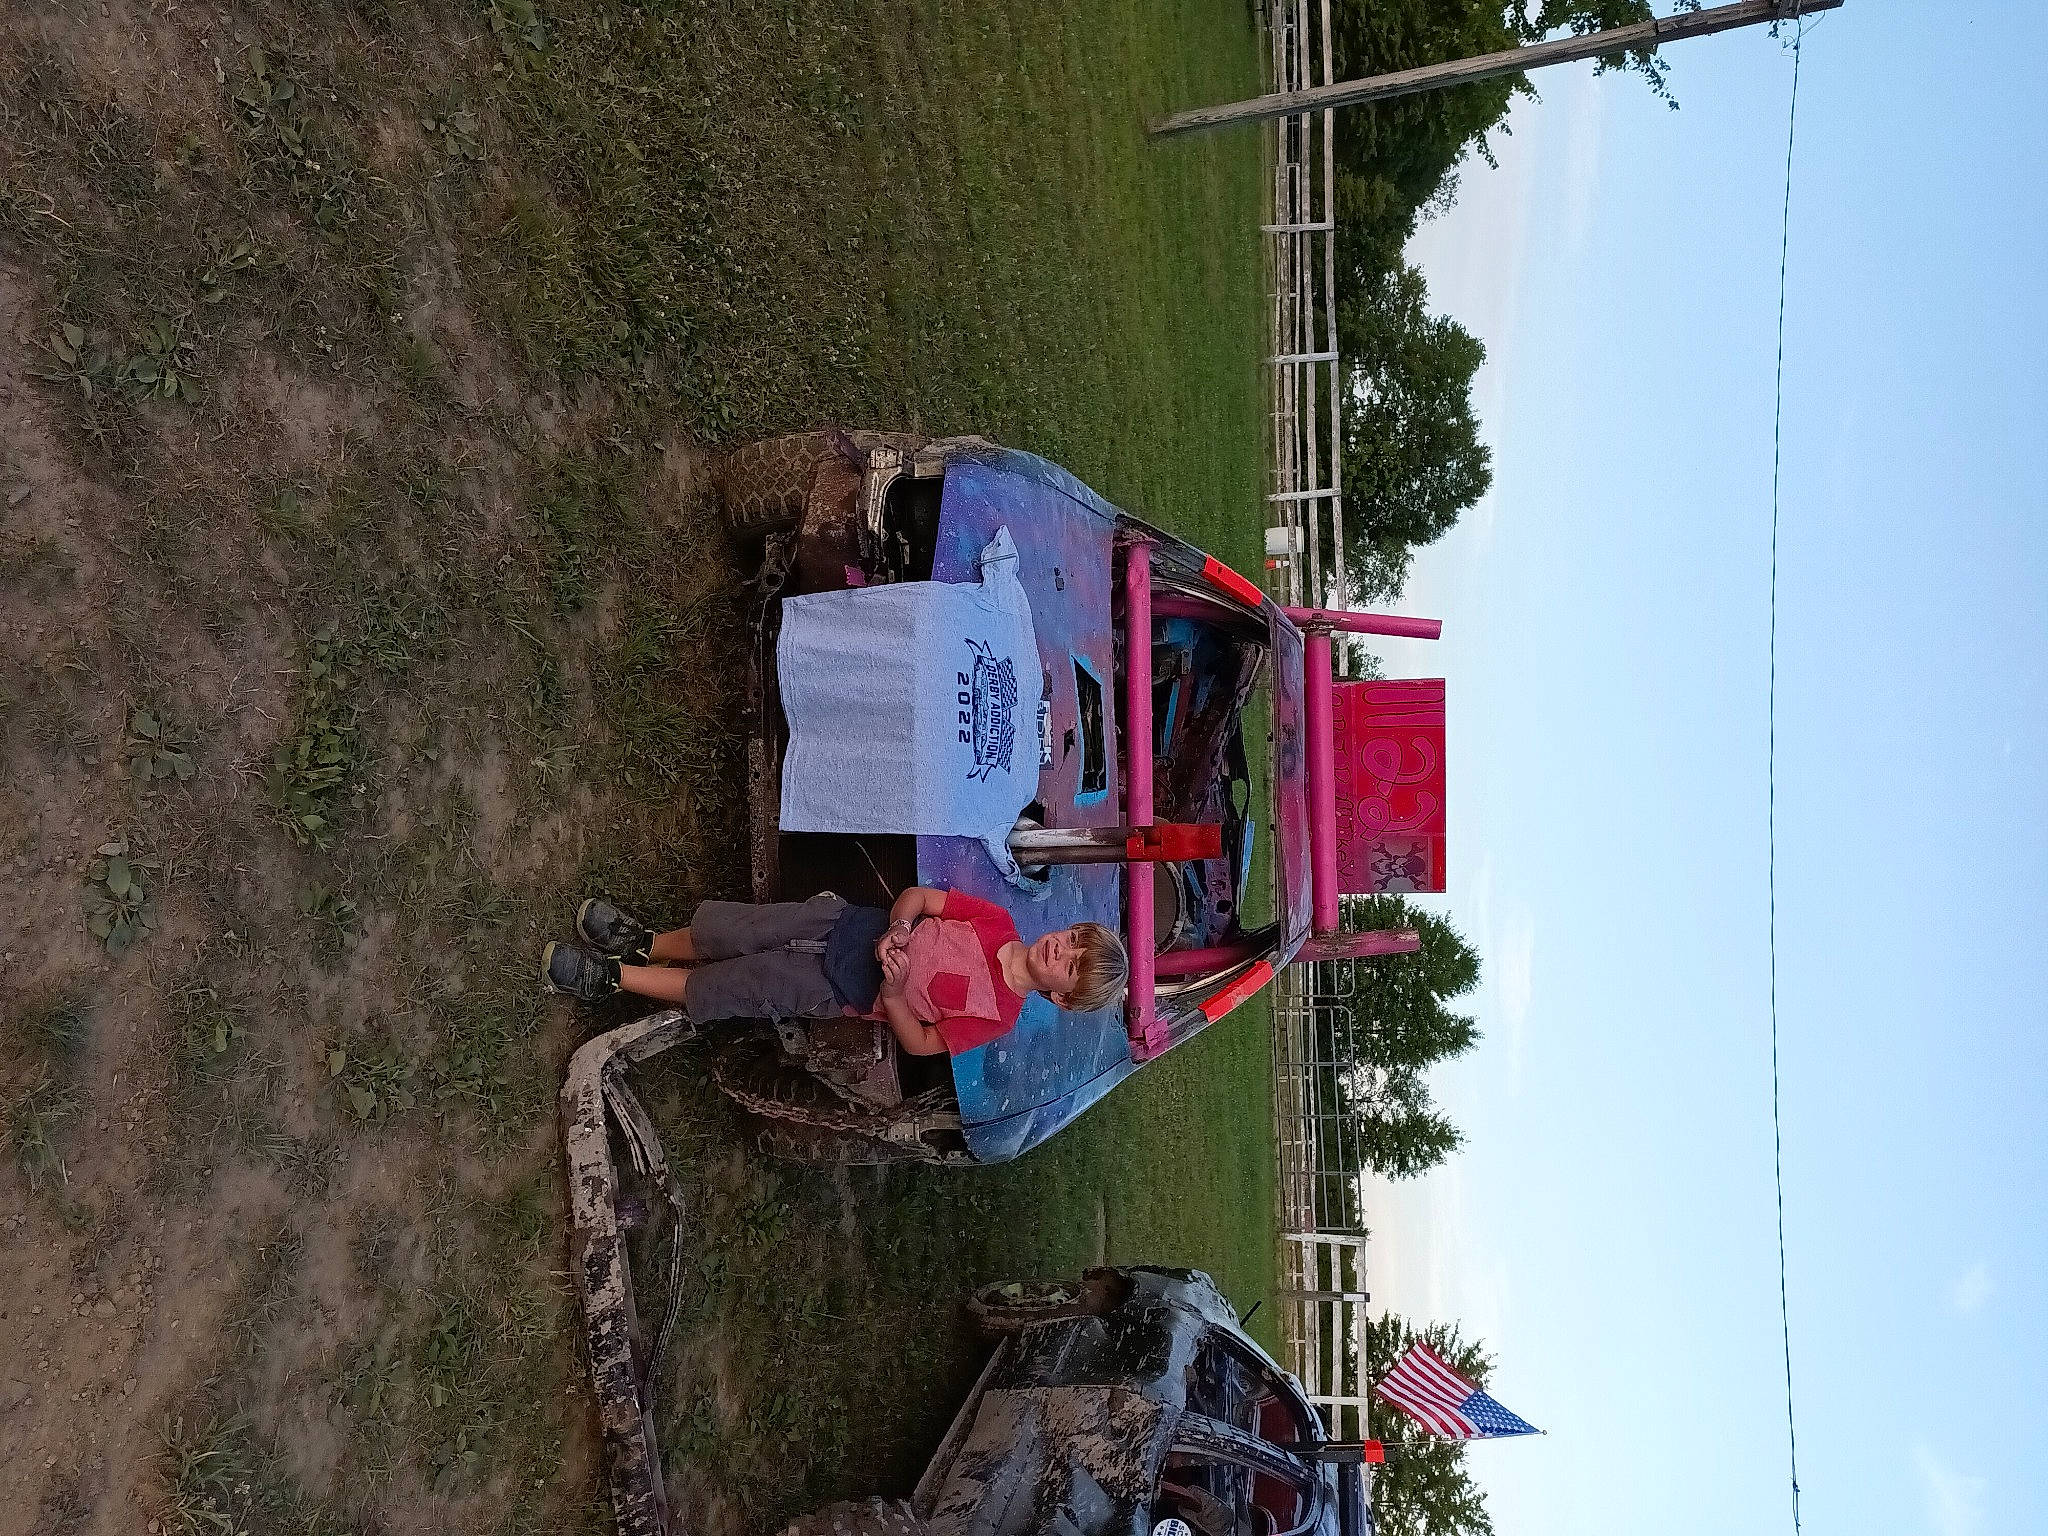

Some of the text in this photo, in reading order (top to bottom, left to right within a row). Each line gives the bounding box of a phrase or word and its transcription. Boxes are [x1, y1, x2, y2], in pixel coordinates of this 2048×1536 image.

[957, 672, 971, 743] 2022
[985, 663, 1001, 759] DERBY ADDICTION
